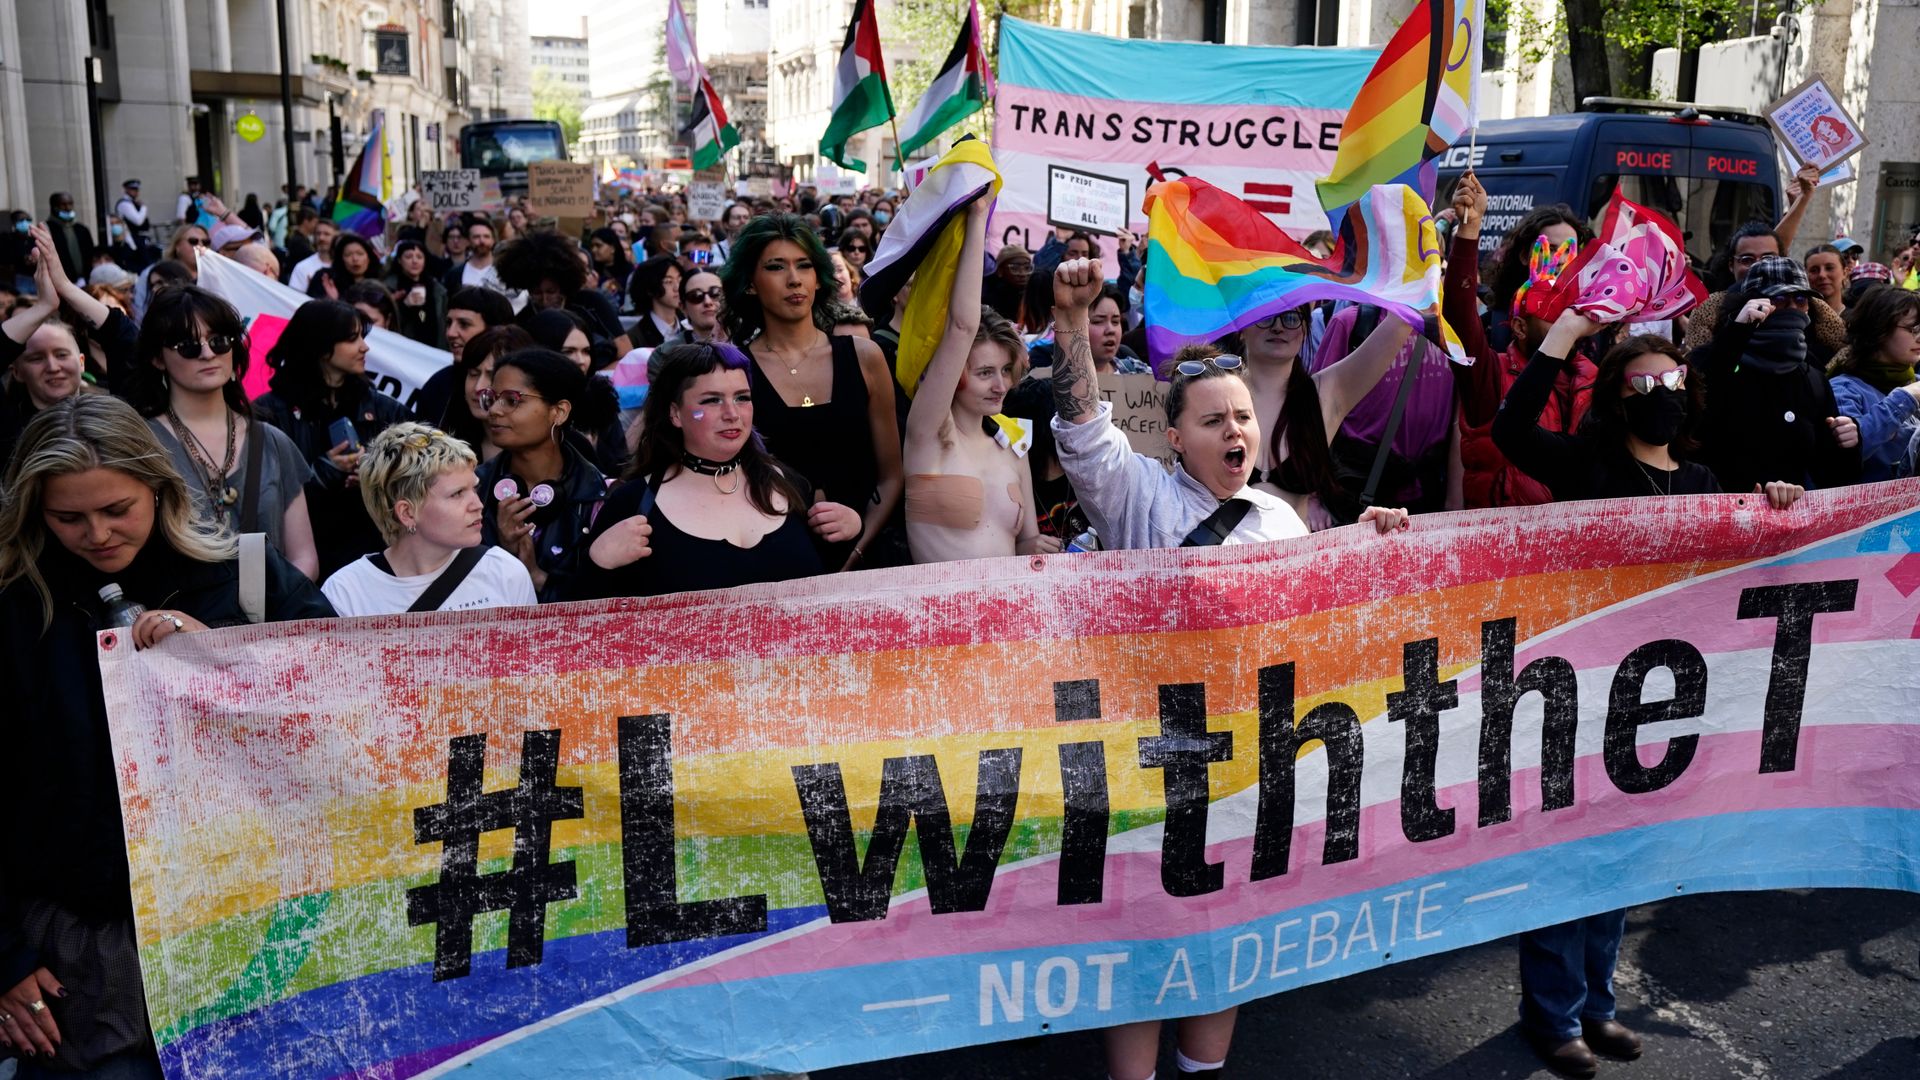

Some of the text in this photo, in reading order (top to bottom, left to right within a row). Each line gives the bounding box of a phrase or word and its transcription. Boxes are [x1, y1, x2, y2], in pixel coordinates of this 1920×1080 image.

[1010, 104, 1343, 151] TRANS STRUGGLE
[1616, 151, 1672, 169] POLICE
[1707, 156, 1757, 175] POLICE
[422, 170, 477, 180] PROTECT
[1070, 175, 1092, 187] PRIDE
[440, 181, 461, 191] THE
[433, 192, 470, 209] DOLLS
[1081, 212, 1098, 224] ALL
[1124, 390, 1165, 409] WAN
[406, 579, 1858, 982] #LwiththeT
[979, 882, 1446, 1026] NOT A DEBATE
